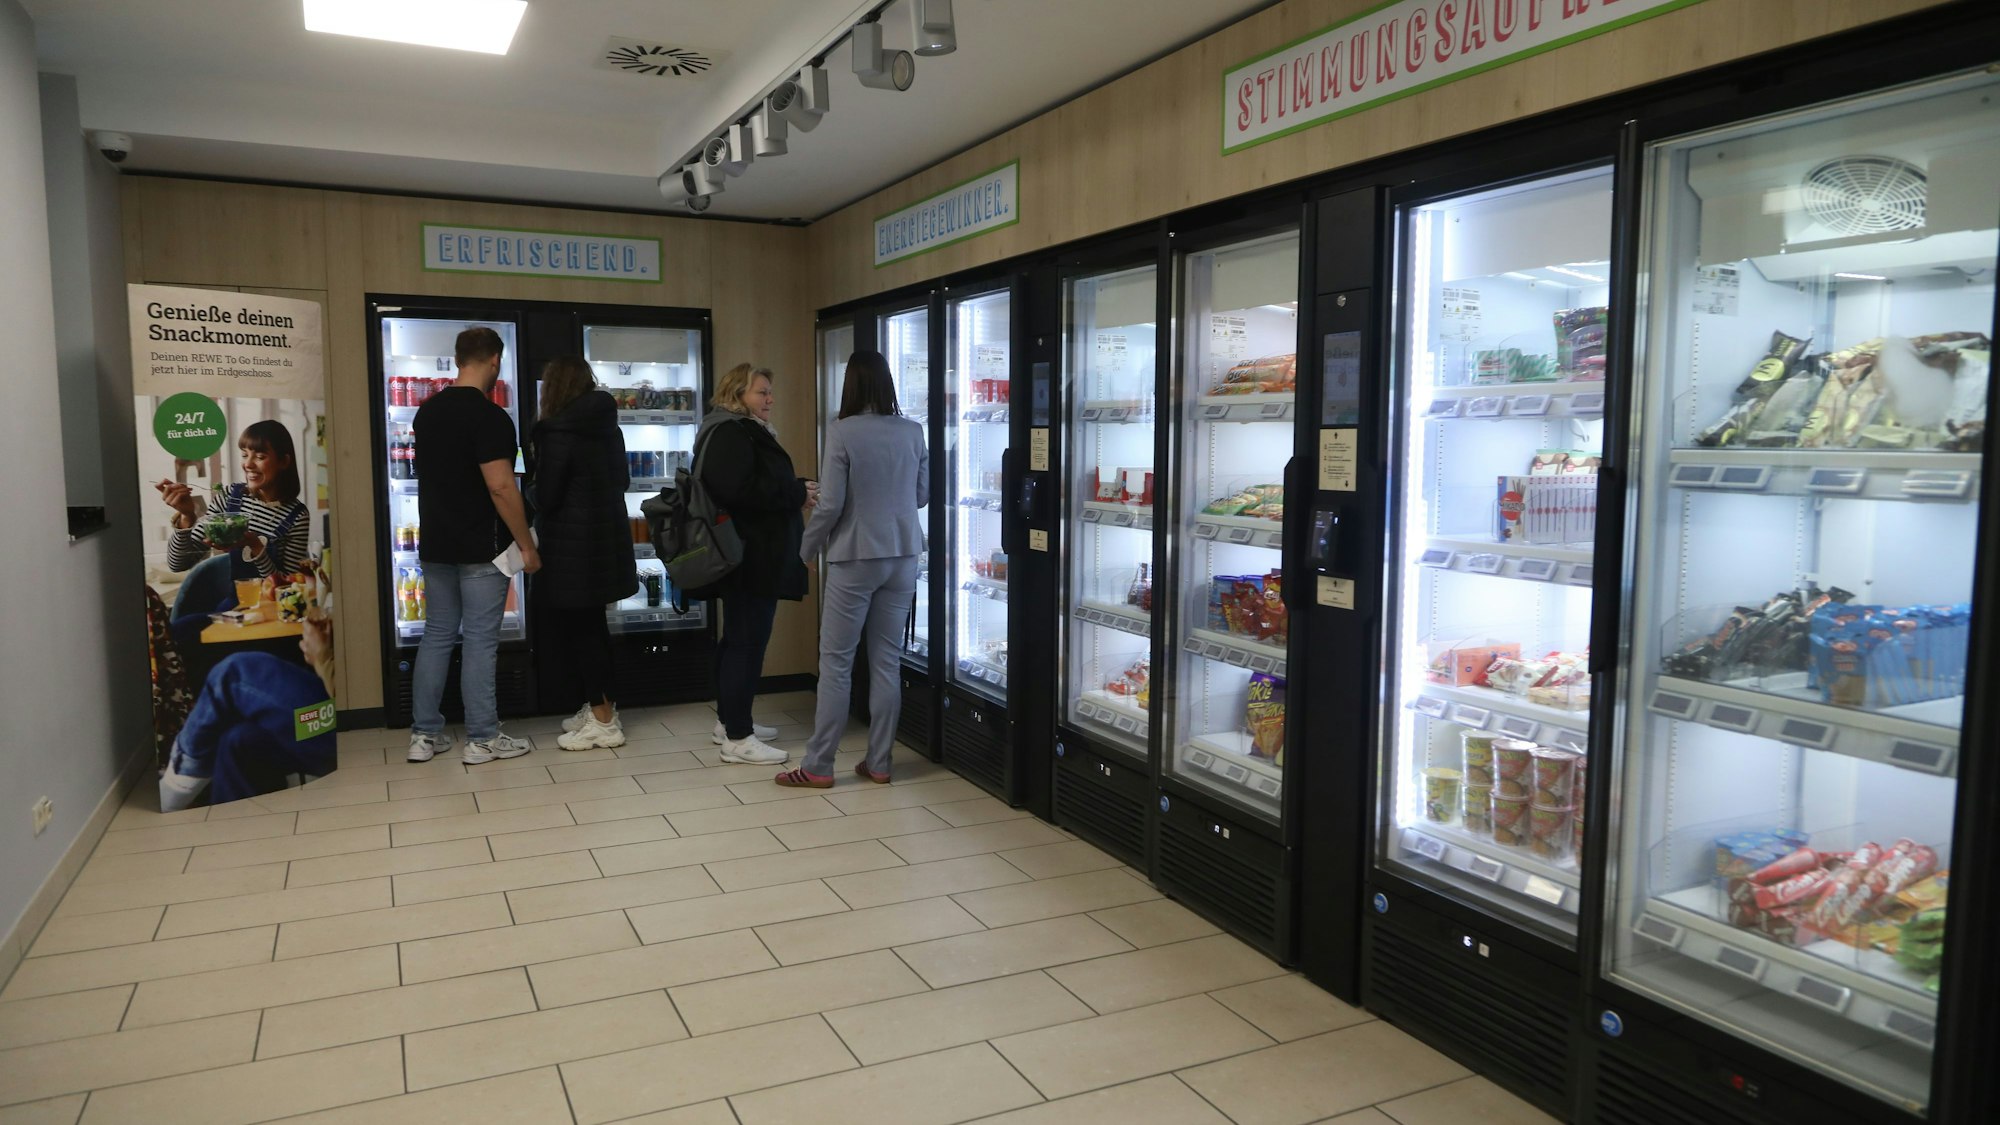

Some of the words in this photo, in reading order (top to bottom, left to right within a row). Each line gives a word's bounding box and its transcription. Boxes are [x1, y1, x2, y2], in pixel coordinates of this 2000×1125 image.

[879, 179, 1009, 256] ENERGIEGEWINNER.
[438, 233, 648, 273] ERFRISCHEND.
[147, 302, 232, 323] Genieße
[237, 308, 294, 329] deinen
[149, 324, 292, 348] Snackmoment.
[151, 352, 188, 363] Deinen
[191, 354, 223, 364] REWE
[225, 355, 237, 364] To
[239, 356, 250, 365] Go
[252, 356, 282, 367] findest
[283, 358, 293, 367] du
[151, 366, 174, 376] jetzt
[177, 365, 197, 375] hier
[201, 367, 215, 376] im
[217, 367, 273, 378] Erdgeschoss.
[174, 412, 205, 425] 24/7
[167, 429, 182, 439] für
[184, 428, 204, 438] dich
[205, 427, 217, 436] da
[300, 710, 319, 722] REWE
[320, 704, 334, 720] GO
[308, 721, 320, 732] TO
